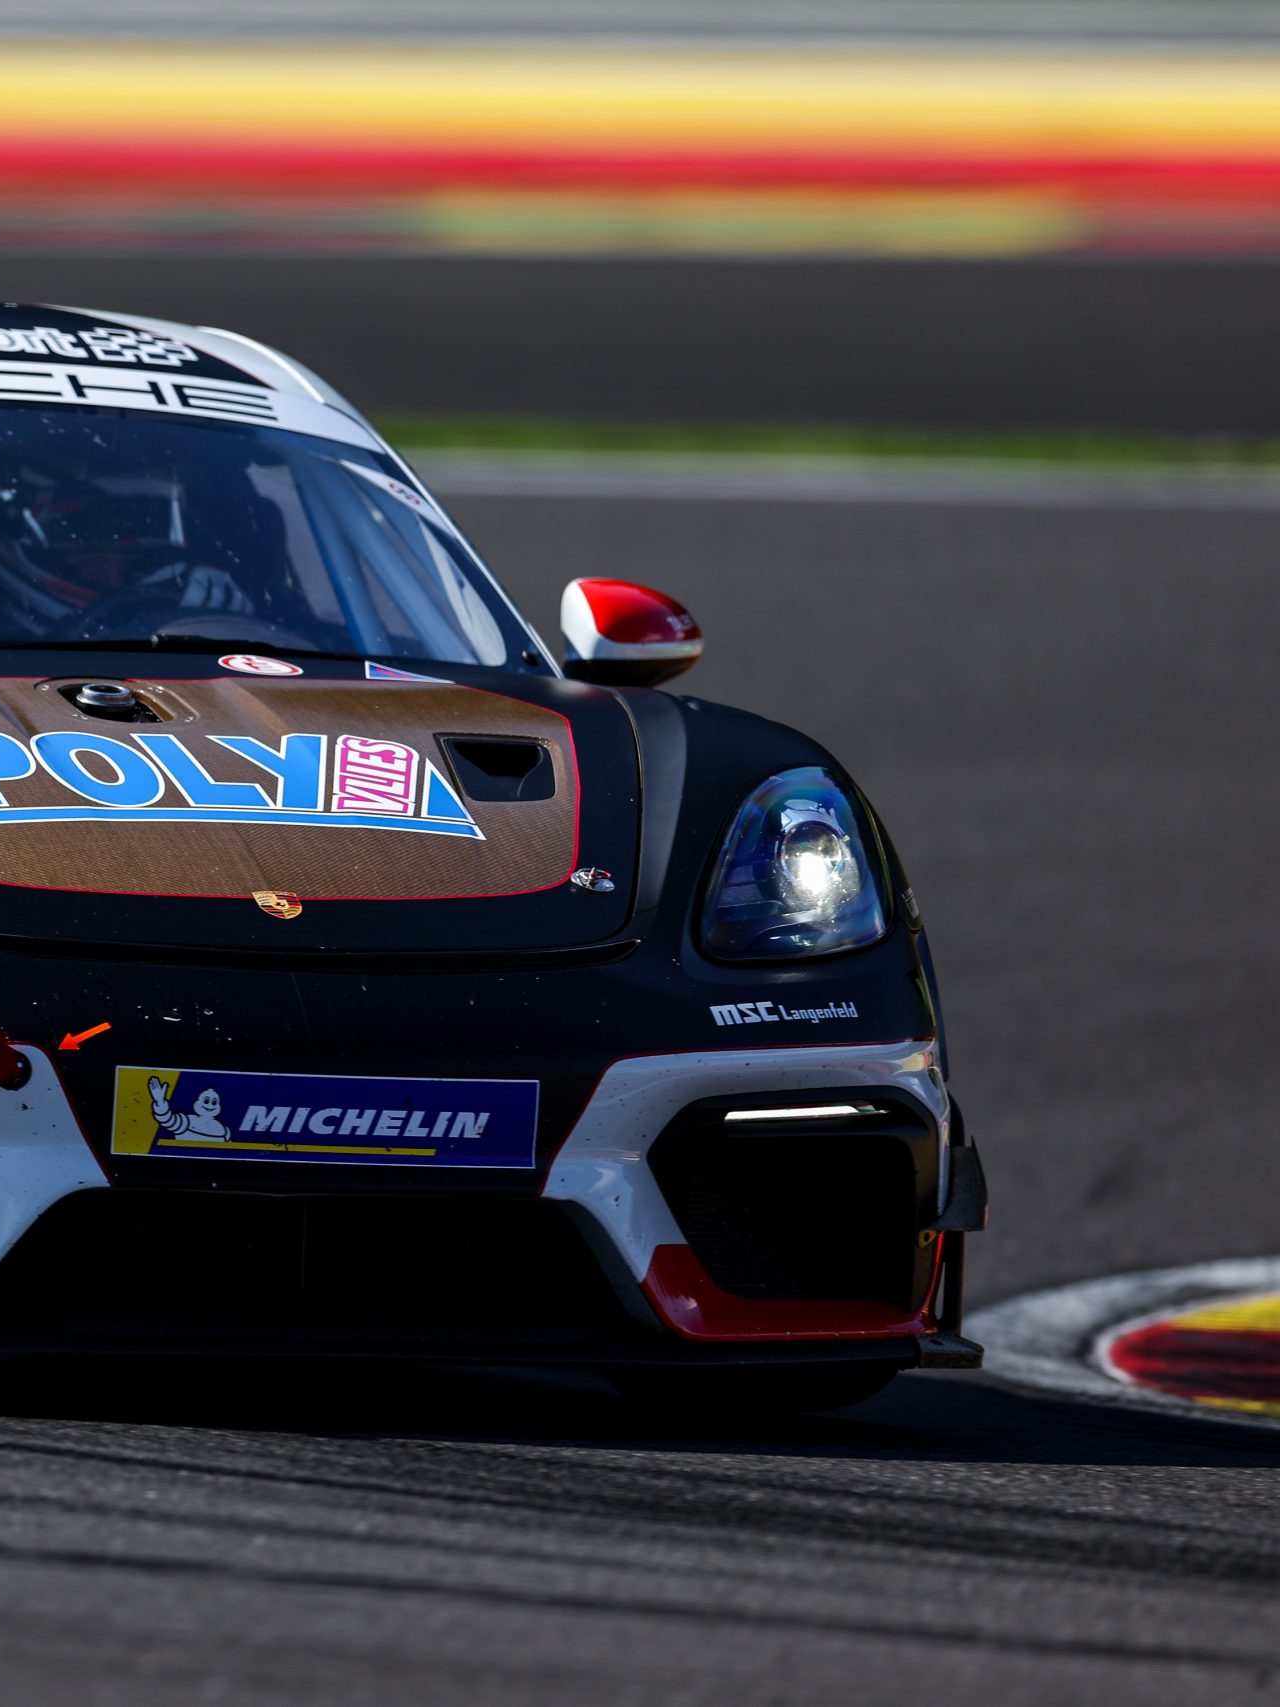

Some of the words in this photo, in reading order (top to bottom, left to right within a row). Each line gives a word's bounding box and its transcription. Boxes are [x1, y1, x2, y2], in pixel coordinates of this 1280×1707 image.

[331, 735, 419, 816] VLIES
[709, 1001, 780, 1026] MSC
[778, 1001, 859, 1024] Langenfeld
[239, 1105, 490, 1138] MICHELIN
